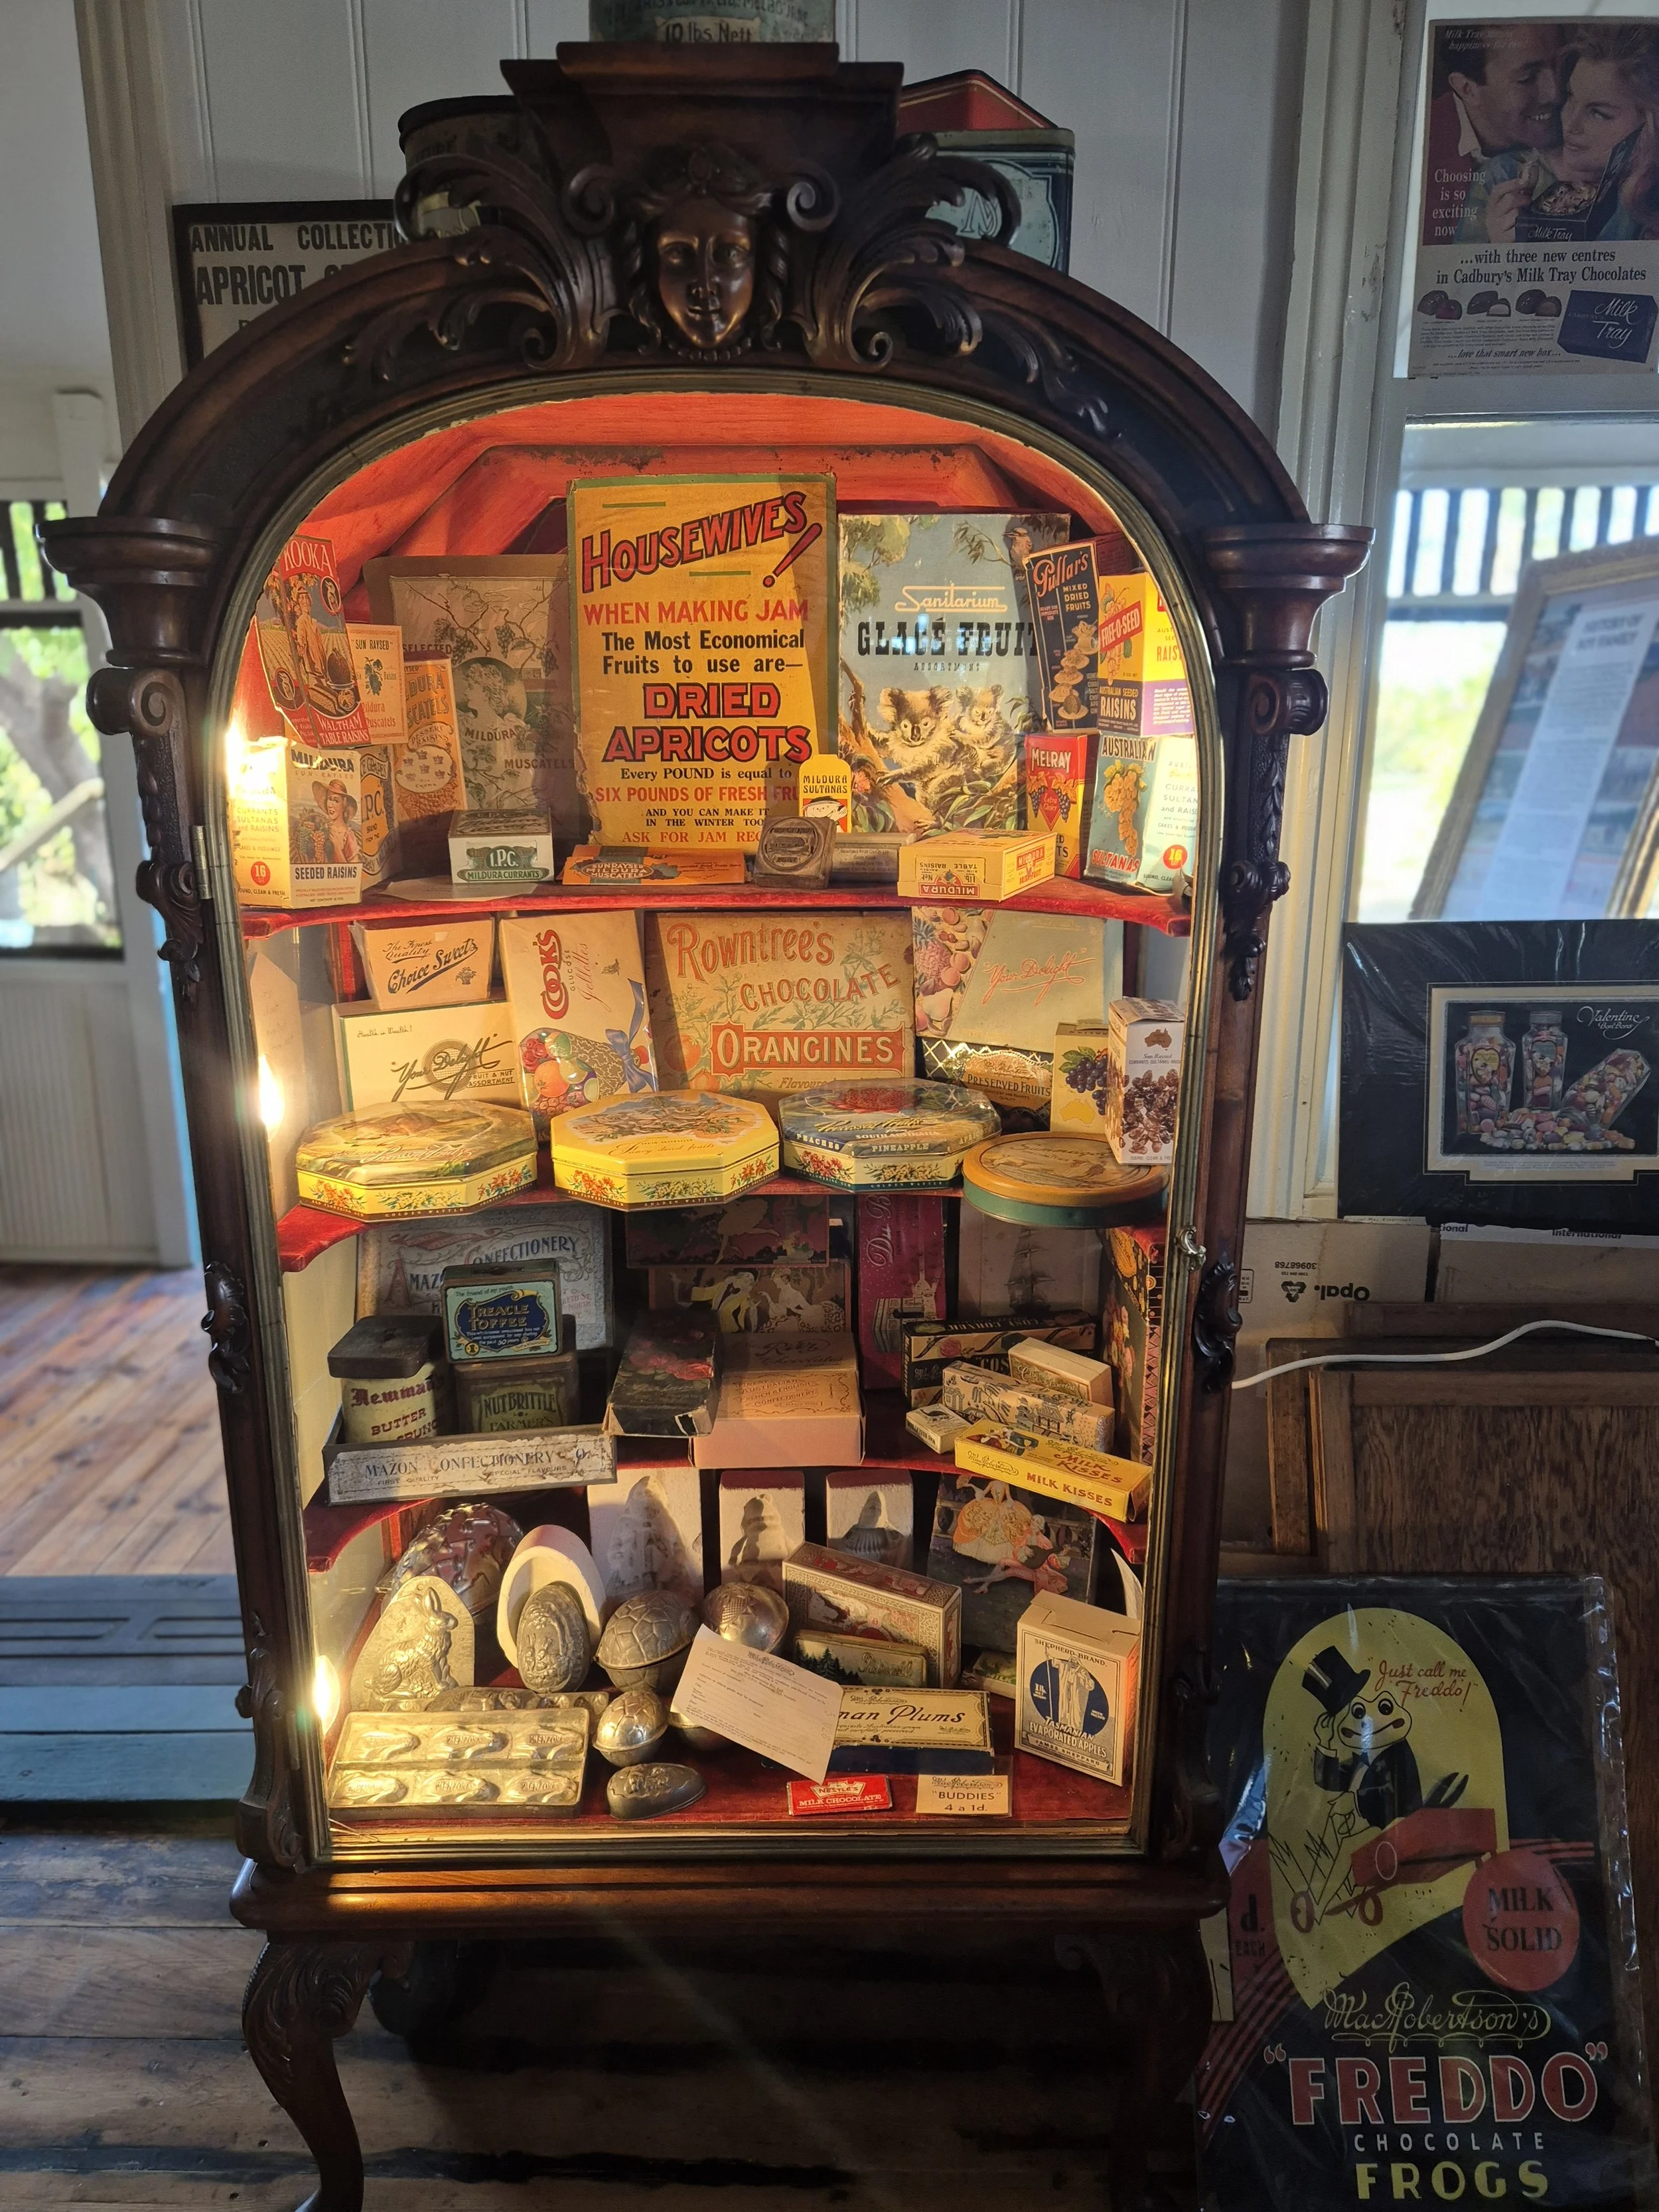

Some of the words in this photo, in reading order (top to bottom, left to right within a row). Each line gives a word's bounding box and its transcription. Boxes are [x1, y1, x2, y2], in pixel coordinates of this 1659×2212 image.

[666, 23, 684, 42] 10
[689, 23, 712, 42] lbs
[719, 23, 752, 42] Nett
[1434, 169, 1486, 184] Choosing
[1441, 187, 1450, 200] is
[1453, 190, 1465, 200] so
[1432, 205, 1478, 220] exciting
[192, 226, 273, 252] ANNUAL
[297, 223, 400, 250] COLLECTI
[1434, 226, 1457, 236] now
[1460, 250, 1501, 264] ...with
[1506, 250, 1538, 262] three
[1543, 252, 1567, 262] new
[1571, 250, 1616, 261] centres
[197, 264, 306, 305] APRICOT
[1436, 270, 1448, 283] in
[1453, 268, 1512, 285] Cadbury's
[1517, 268, 1544, 282] Milk
[1549, 267, 1577, 283] Tray
[1581, 266, 1646, 280] Chocolates
[1595, 298, 1639, 325] Milk
[1593, 320, 1632, 349] Tray
[1448, 348, 1473, 359] ...love
[1475, 349, 1492, 358] that
[1493, 349, 1518, 358] smart
[1537, 348, 1561, 357] box...
[283, 538, 332, 579] KOOKA
[1033, 552, 1090, 597] Pullar's
[895, 583, 1008, 613] Sanitarium
[1063, 583, 1088, 593] MIXED
[1064, 592, 1089, 602] DRIED
[583, 601, 650, 626] WHEN
[658, 599, 749, 623] MAKING
[755, 599, 809, 622] JAM
[1066, 601, 1092, 613] FRUITS
[1100, 608, 1141, 649] FREE-O-SEED
[602, 632, 635, 651] The
[644, 630, 691, 650] Most
[700, 629, 805, 650] Economical
[603, 656, 660, 674] Fruits
[673, 655, 693, 673] to
[707, 658, 740, 672] use
[644, 682, 781, 719] DRIED
[1100, 698, 1137, 721] RAISINS
[317, 712, 362, 731] WALTHAM
[319, 731, 340, 746] TABLE
[341, 729, 370, 743] RAISINS
[466, 727, 518, 741] MILDURA
[602, 725, 812, 763] APRICOTS
[1101, 736, 1156, 763] AUSTRALIAN
[291, 749, 355, 773] MILDURA
[504, 758, 575, 771] MUSCATELS
[1031, 747, 1071, 773] MELRAY
[621, 767, 658, 783] Every
[663, 767, 714, 779] POUND
[721, 768, 731, 778] is
[737, 767, 772, 782] equal
[779, 767, 792, 779] to
[802, 774, 847, 784] MILDURA
[596, 787, 621, 802] SIX
[626, 786, 691, 802] POUNDS
[694, 786, 713, 801] OF
[719, 786, 766, 801] FRESH
[773, 786, 799, 800] FRU
[802, 784, 848, 794] SULTANAS
[646, 807, 667, 817] AND
[672, 807, 693, 817] YOU
[699, 807, 719, 817] CAN
[724, 807, 755, 816] MAKE
[758, 806, 770, 816] IT
[646, 818, 657, 827] IN
[665, 818, 686, 827] THE
[693, 818, 735, 827] WINTER
[622, 832, 650, 843] ASK
[660, 831, 689, 843] FOR
[697, 830, 727, 842] JAM
[736, 830, 761, 842] REC
[490, 848, 518, 868] I.P.C.
[1092, 848, 1140, 871] SULTANAS
[295, 867, 325, 880] SEEDED
[326, 865, 358, 879] RAISINS
[467, 870, 503, 881] MILDURA
[503, 869, 540, 881] CURRANTS
[921, 885, 977, 896] MILDURA
[666, 921, 834, 985] Rowntree's
[388, 965, 430, 994] Choice
[433, 936, 479, 970] Sweets
[532, 928, 570, 1020] COOK'S
[561, 948, 575, 992] GLUCOSE
[739, 962, 902, 1012] CHOCOLATE
[1577, 1005, 1650, 1035] Valentine
[717, 1027, 894, 1070] ORANGINES
[467, 1076, 514, 1087] ASSORTMENT
[967, 1074, 1019, 1092] PRESERVED
[1021, 1080, 1051, 1097] FRUITS
[796, 1133, 840, 1151] PEACHES
[871, 1142, 930, 1152] PINEAPPLE
[427, 1207, 465, 1216] WATTLE
[465, 1234, 579, 1264] CONFECTIONERY
[1275, 1261, 1317, 1270] 30968768
[1314, 1284, 1370, 1302] Opal.
[467, 1303, 530, 1318] TREACLE
[469, 1316, 527, 1331] TOFFEE
[371, 1408, 427, 1436] BUTTER
[1054, 1453, 1112, 1473] MILK
[1056, 1461, 1123, 1485] KISSES
[406, 1475, 440, 1483] QUALITY
[1026, 1471, 1059, 1490] MILK
[1062, 1483, 1114, 1507] KISSES
[1034, 1637, 1076, 1657] SHEPHERD
[1077, 1651, 1108, 1667] BRAND.
[1417, 1662, 1446, 1678] call
[1449, 1665, 1468, 1678] me
[839, 1710, 879, 1724] man
[890, 1704, 966, 1729] Plums
[1045, 1716, 1095, 1741] TASMANIAN
[1029, 1721, 1078, 1747] EVAPORATED
[1077, 1737, 1107, 1758] APPLES
[1035, 1739, 1058, 1752] JAMES
[1060, 1748, 1101, 1767] SHEPPARD
[798, 1798, 826, 1806] MILK
[826, 1794, 883, 1805] CHOCOLATE
[932, 1790, 1002, 1801] "BUDDIES"
[1488, 1887, 1555, 1912] MILK
[1486, 1927, 1563, 1953] SOLID
[1323, 1982, 1551, 2053] MacRobertson's
[1263, 2041, 1609, 2125] "FREDDO"
[1354, 2132, 1545, 2152] CHOCOLATE
[1354, 2160, 1549, 2200] FROGS
